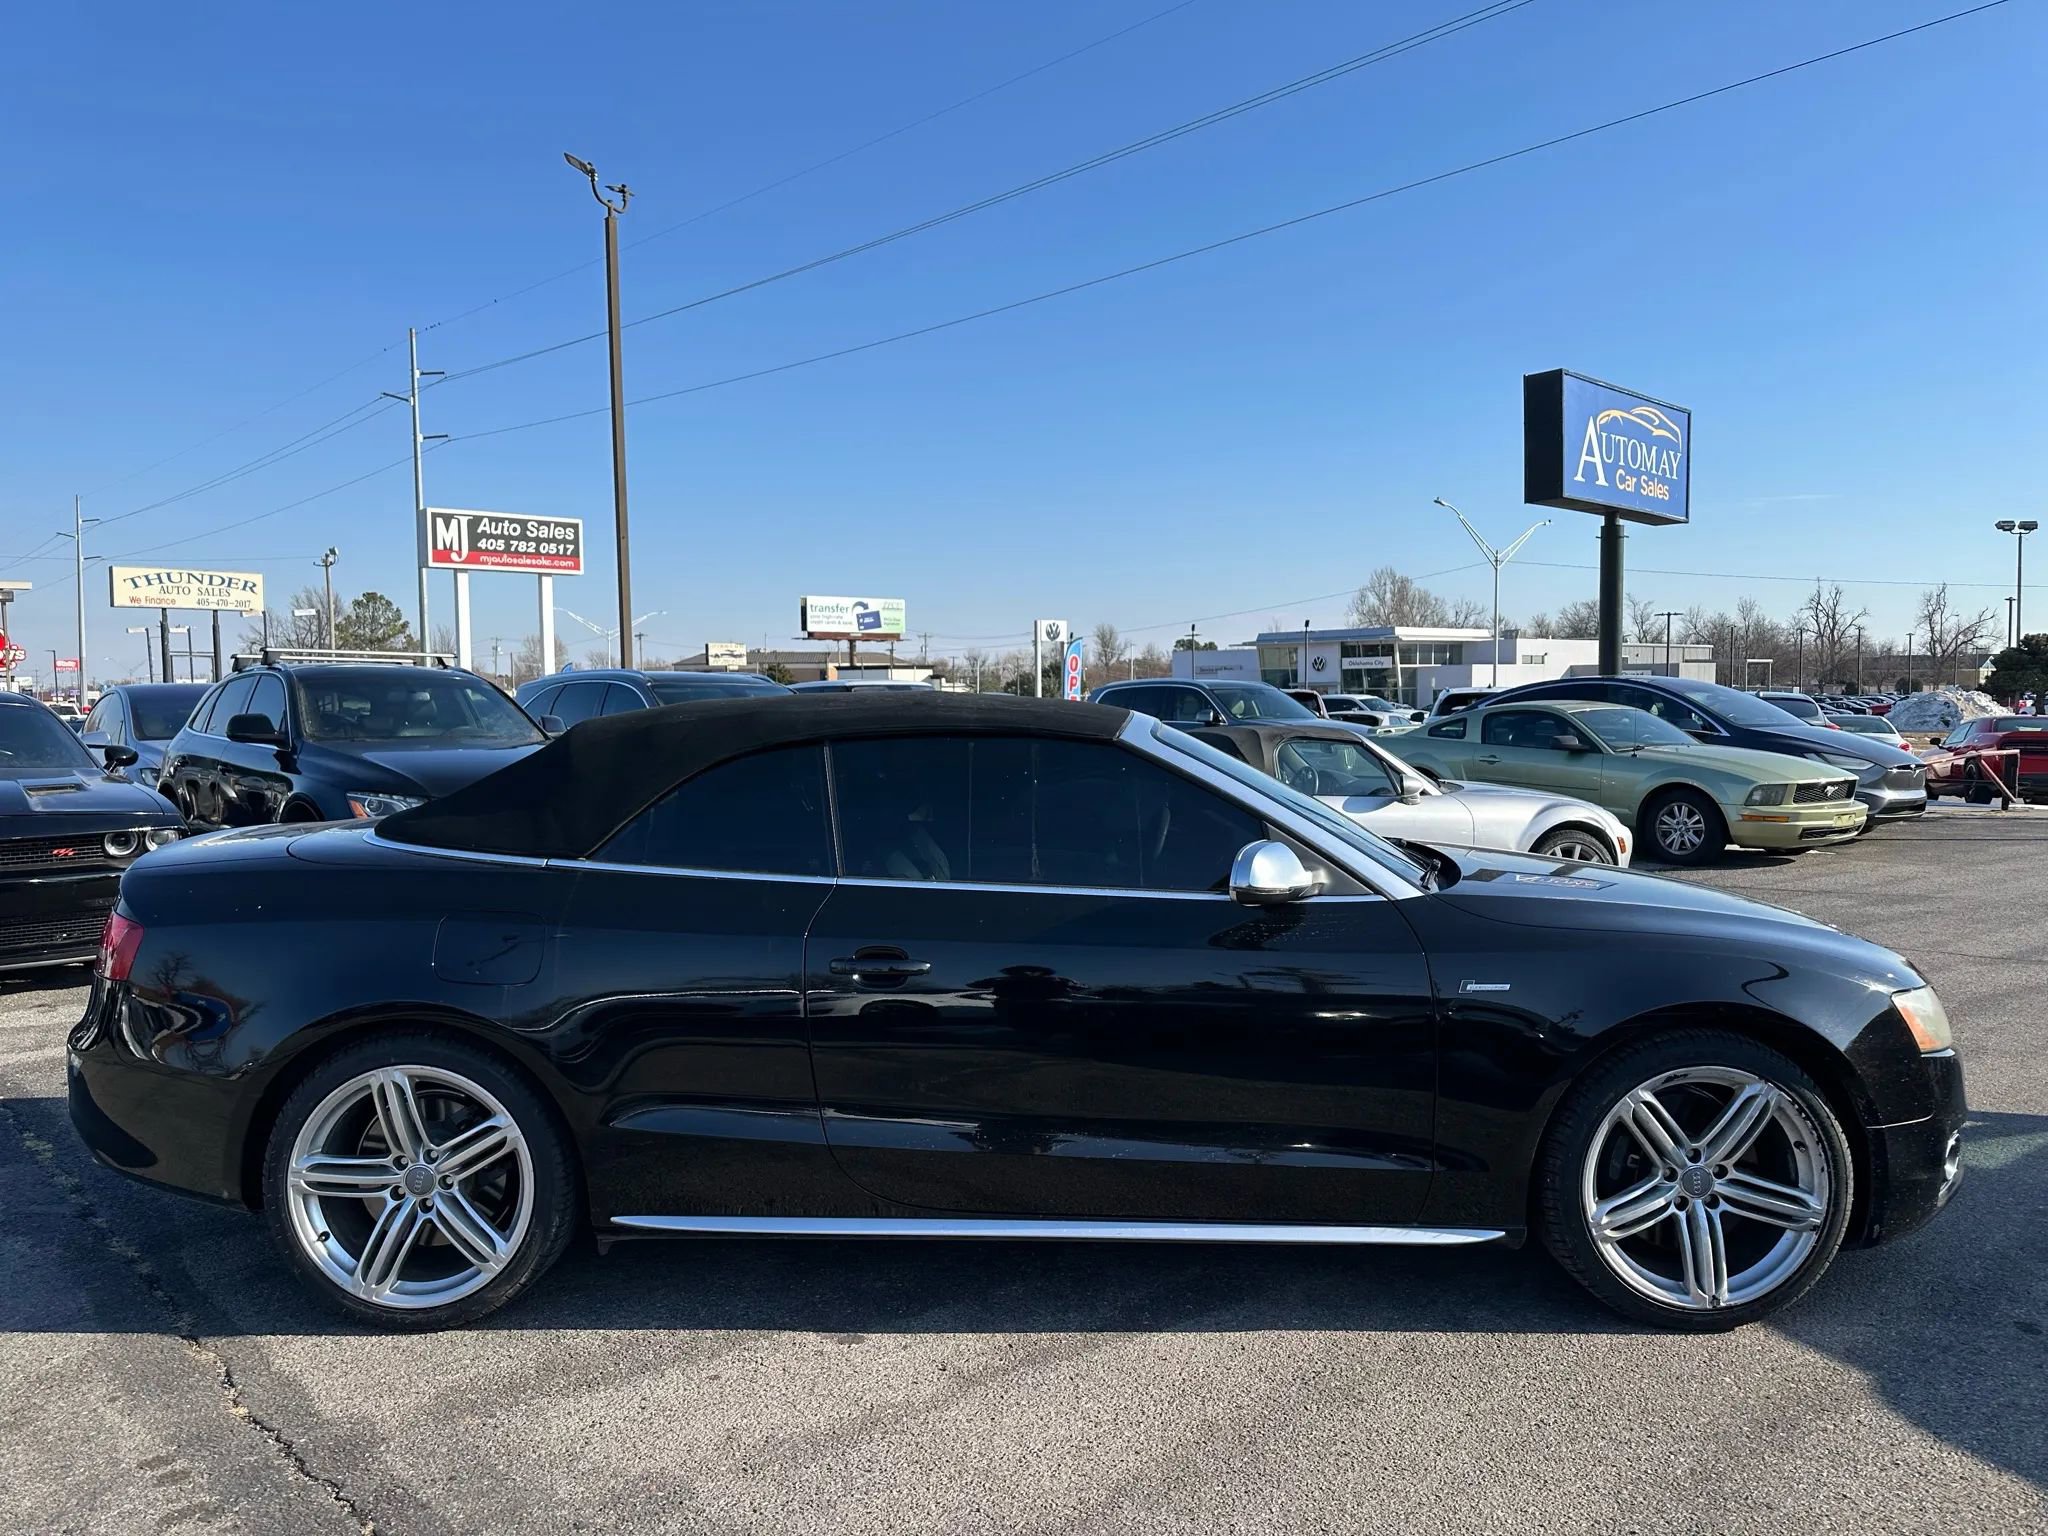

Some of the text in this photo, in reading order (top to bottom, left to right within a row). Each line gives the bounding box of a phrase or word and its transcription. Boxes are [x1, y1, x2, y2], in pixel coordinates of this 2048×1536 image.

[1574, 415, 1682, 487] AUTOMAY
[1615, 468, 1670, 501] Car Sales
[477, 517, 576, 541] Auto Sales
[435, 514, 474, 563] MJ
[477, 538, 575, 556] 405 782 0517
[479, 553, 575, 568] mjautosalesokc.com
[123, 571, 258, 595] THUNDER
[158, 585, 232, 598] AUTO SALES
[128, 595, 177, 606] We Finance
[196, 598, 251, 608] 405-470-2017
[810, 603, 850, 614] transfer
[1348, 659, 1384, 667] Oklahoma City
